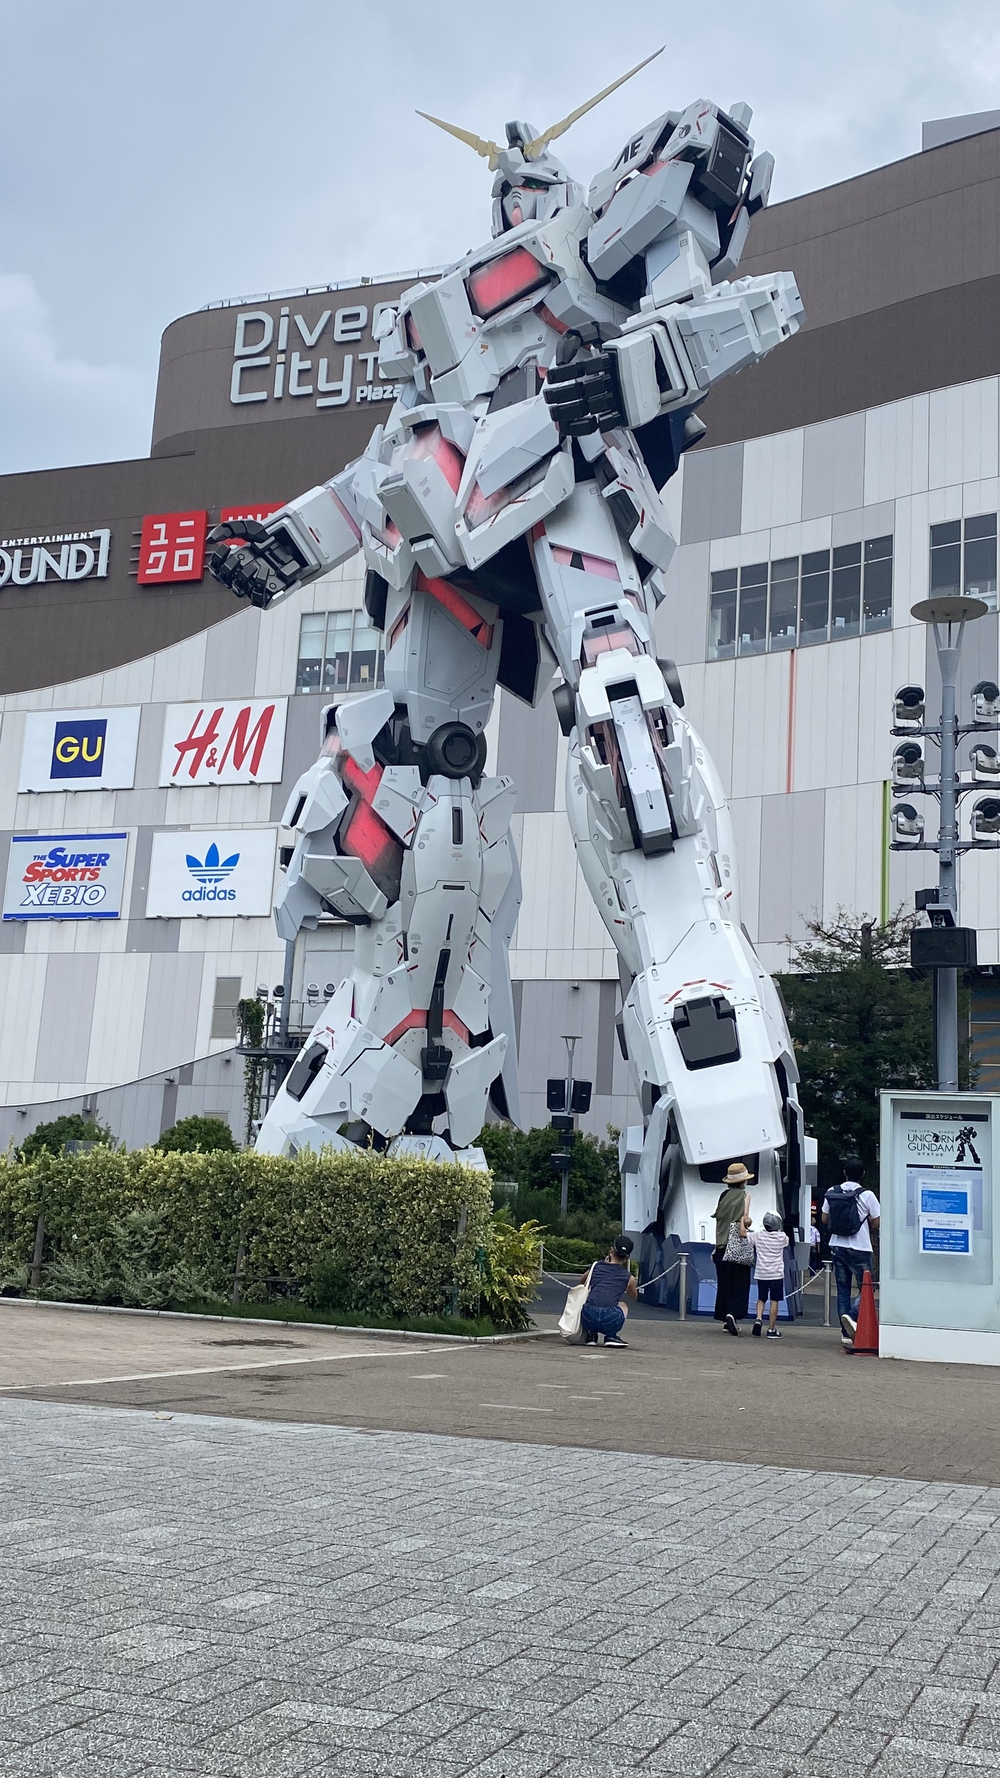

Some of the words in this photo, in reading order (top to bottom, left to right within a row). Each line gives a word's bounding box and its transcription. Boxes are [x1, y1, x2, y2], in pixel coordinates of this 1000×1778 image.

[230, 351, 353, 408] City
[356, 384, 402, 403] Plaza
[1, 531, 95, 547] ENTERTAINMENT
[55, 736, 103, 763] GU
[172, 704, 276, 779] H&M
[44, 846, 111, 868] SUPER
[22, 861, 101, 883] SPORTS
[20, 882, 106, 907] XEBIO
[181, 886, 236, 902] adidas
[907, 1133, 955, 1143] UNICORN
[907, 1142, 955, 1152] GUNDAM
